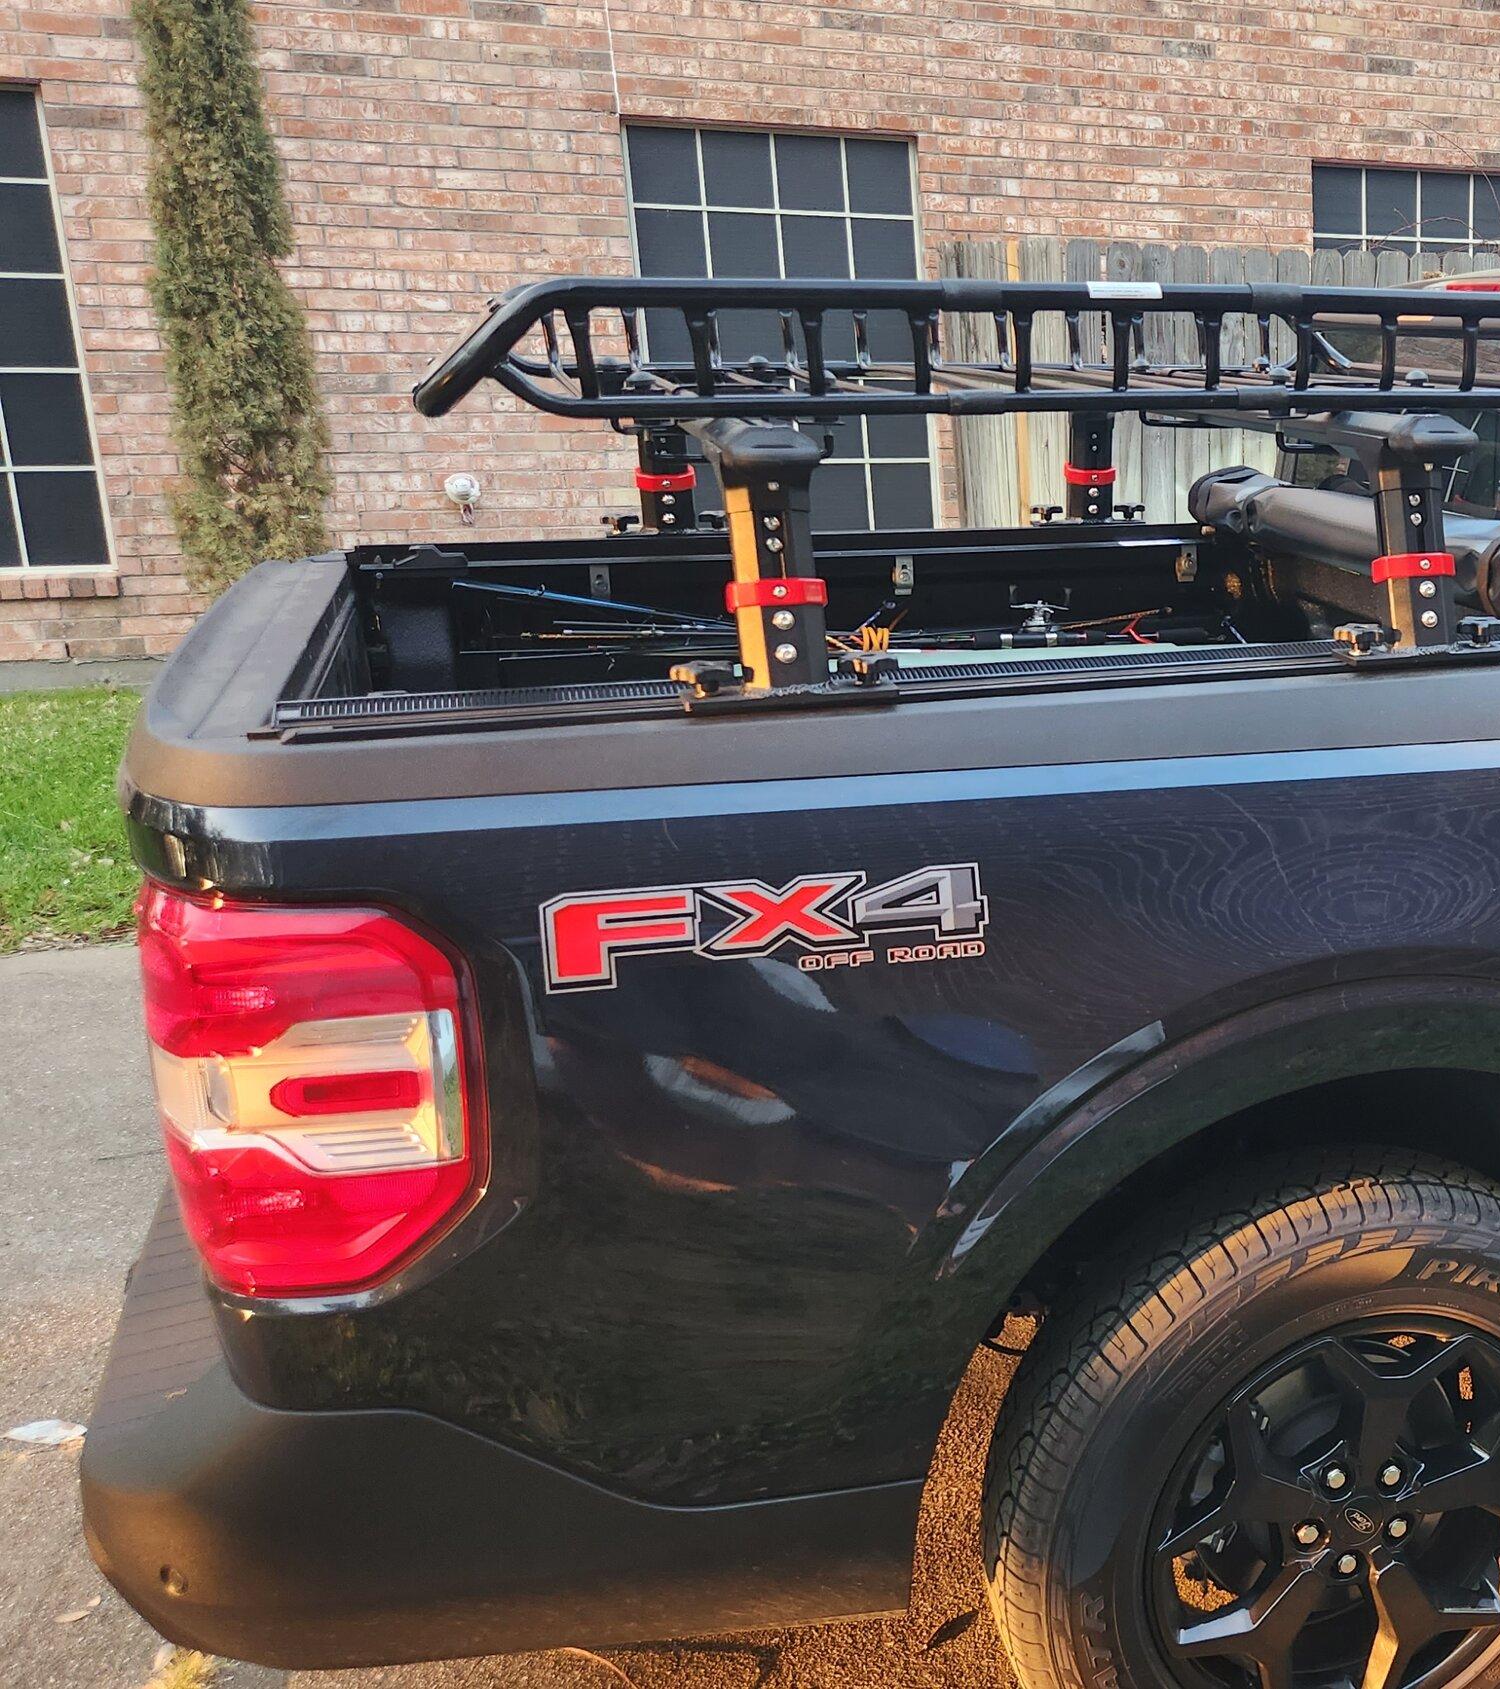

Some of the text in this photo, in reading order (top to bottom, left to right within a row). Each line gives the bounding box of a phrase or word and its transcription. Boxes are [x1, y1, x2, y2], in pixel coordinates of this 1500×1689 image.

[539, 863, 989, 994] FX4
[799, 940, 985, 971] OFF ROAD
